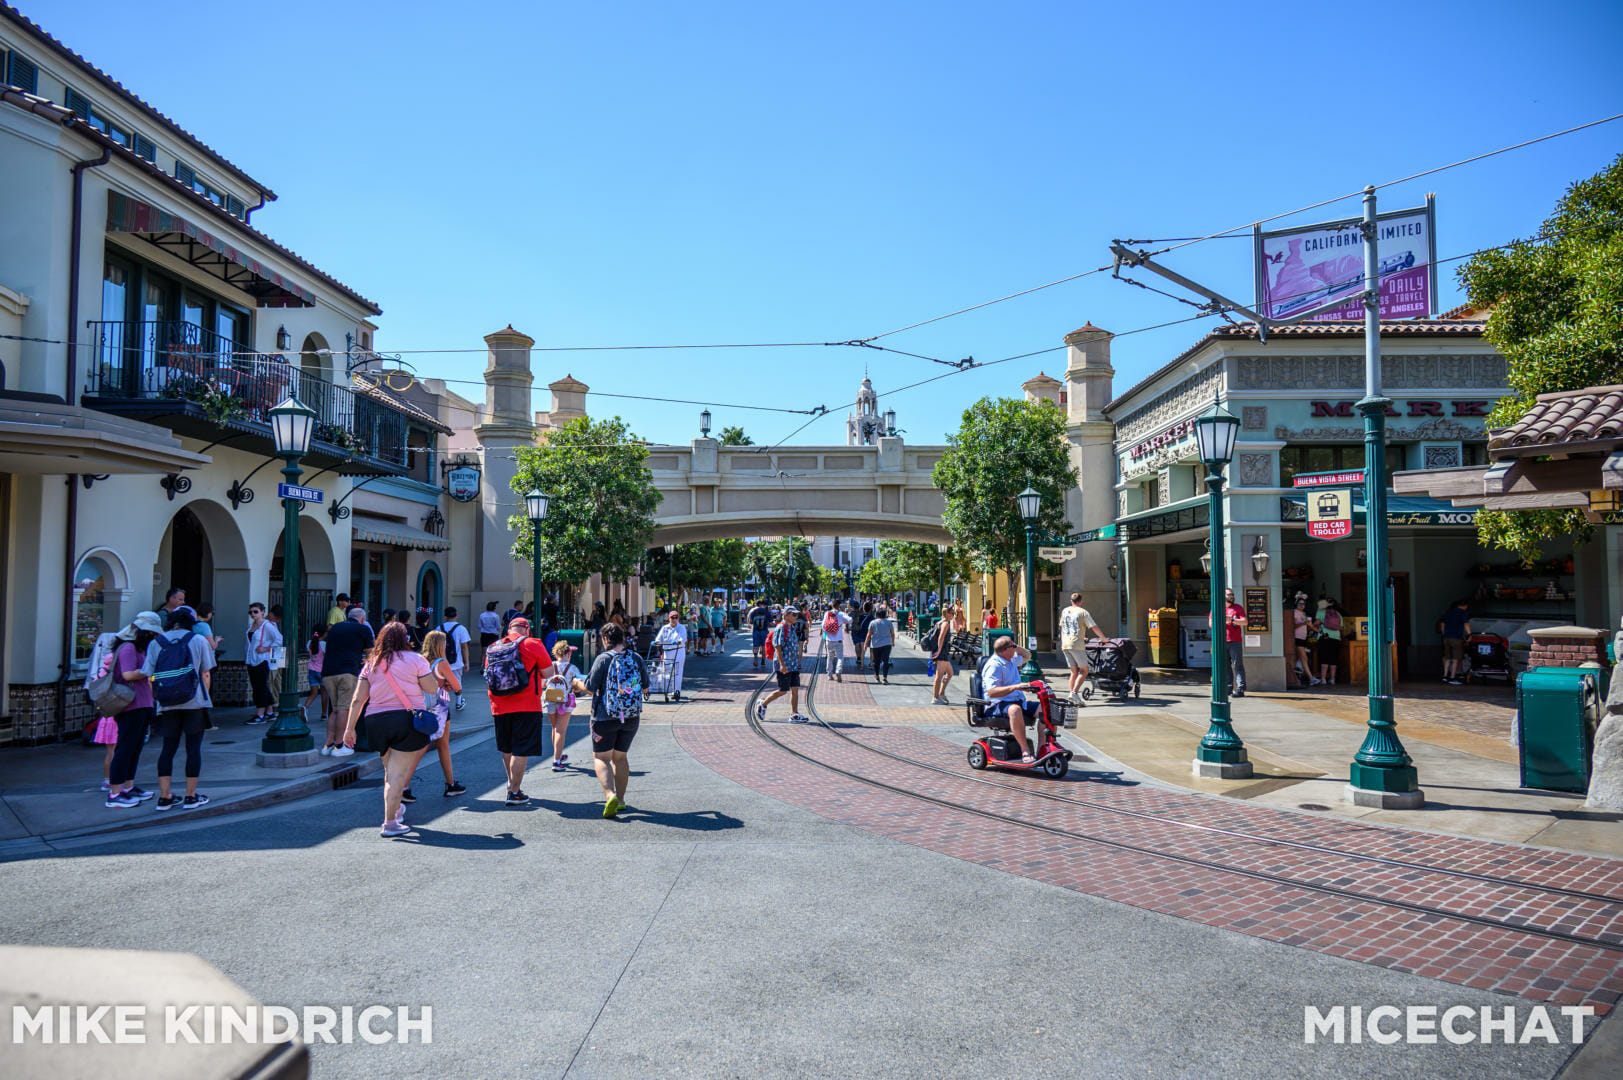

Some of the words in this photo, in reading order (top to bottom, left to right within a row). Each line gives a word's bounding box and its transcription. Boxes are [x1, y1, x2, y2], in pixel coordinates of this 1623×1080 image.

[1305, 232, 1363, 251] CALIFORNI
[1377, 222, 1421, 241] IMITED
[1390, 276, 1424, 293] DAILY
[1346, 310, 1363, 319] CITY
[1391, 303, 1424, 313] ANGELES
[1130, 416, 1198, 459] MARKET
[1297, 477, 1317, 485] BUENA
[1318, 475, 1336, 483] VISTA
[1338, 473, 1360, 481] STREET
[1408, 513, 1432, 524] Fruit
[1313, 528, 1346, 536] TROLLEY
